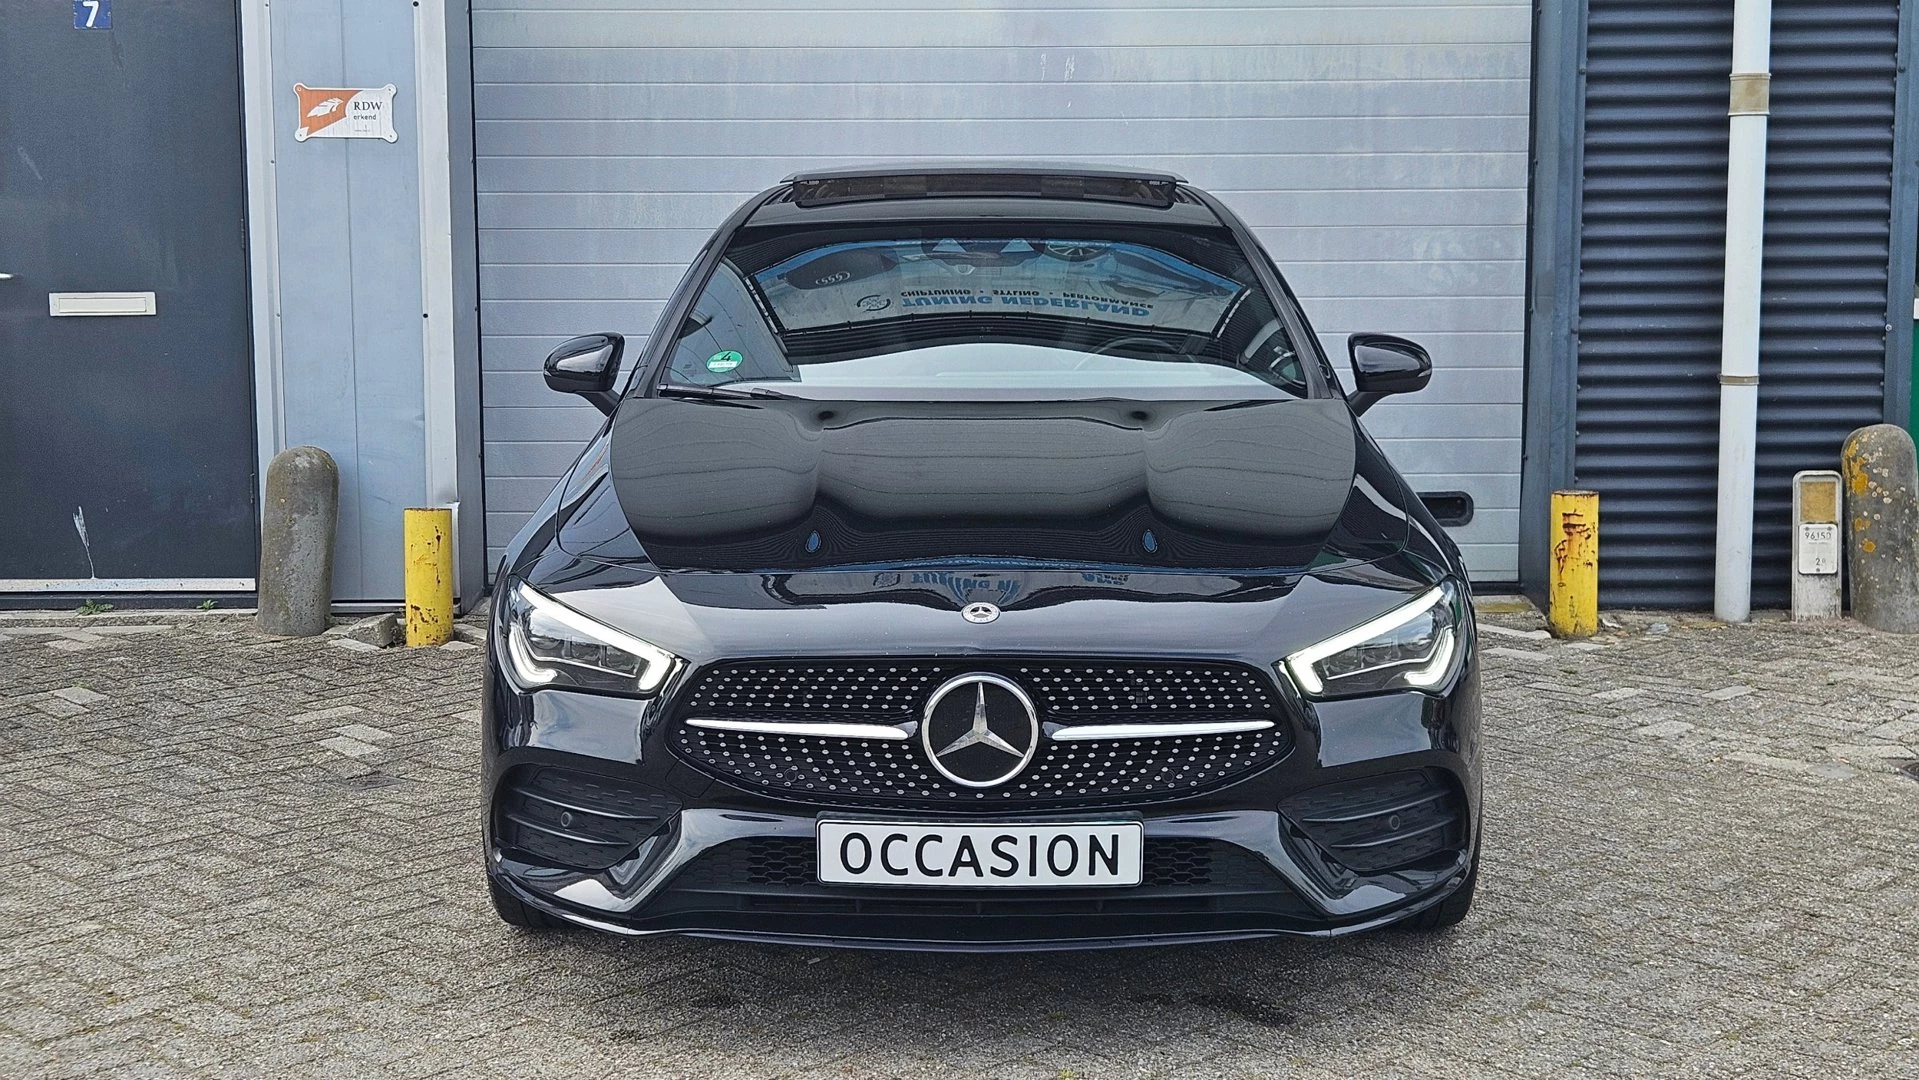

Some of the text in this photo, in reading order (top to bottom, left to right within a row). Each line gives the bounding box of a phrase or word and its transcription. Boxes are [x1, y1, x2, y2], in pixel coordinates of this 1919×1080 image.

[82, 0, 99, 28] 7
[353, 101, 383, 111] RDW
[721, 352, 732, 361] 4
[839, 832, 1119, 878] OCCASION
